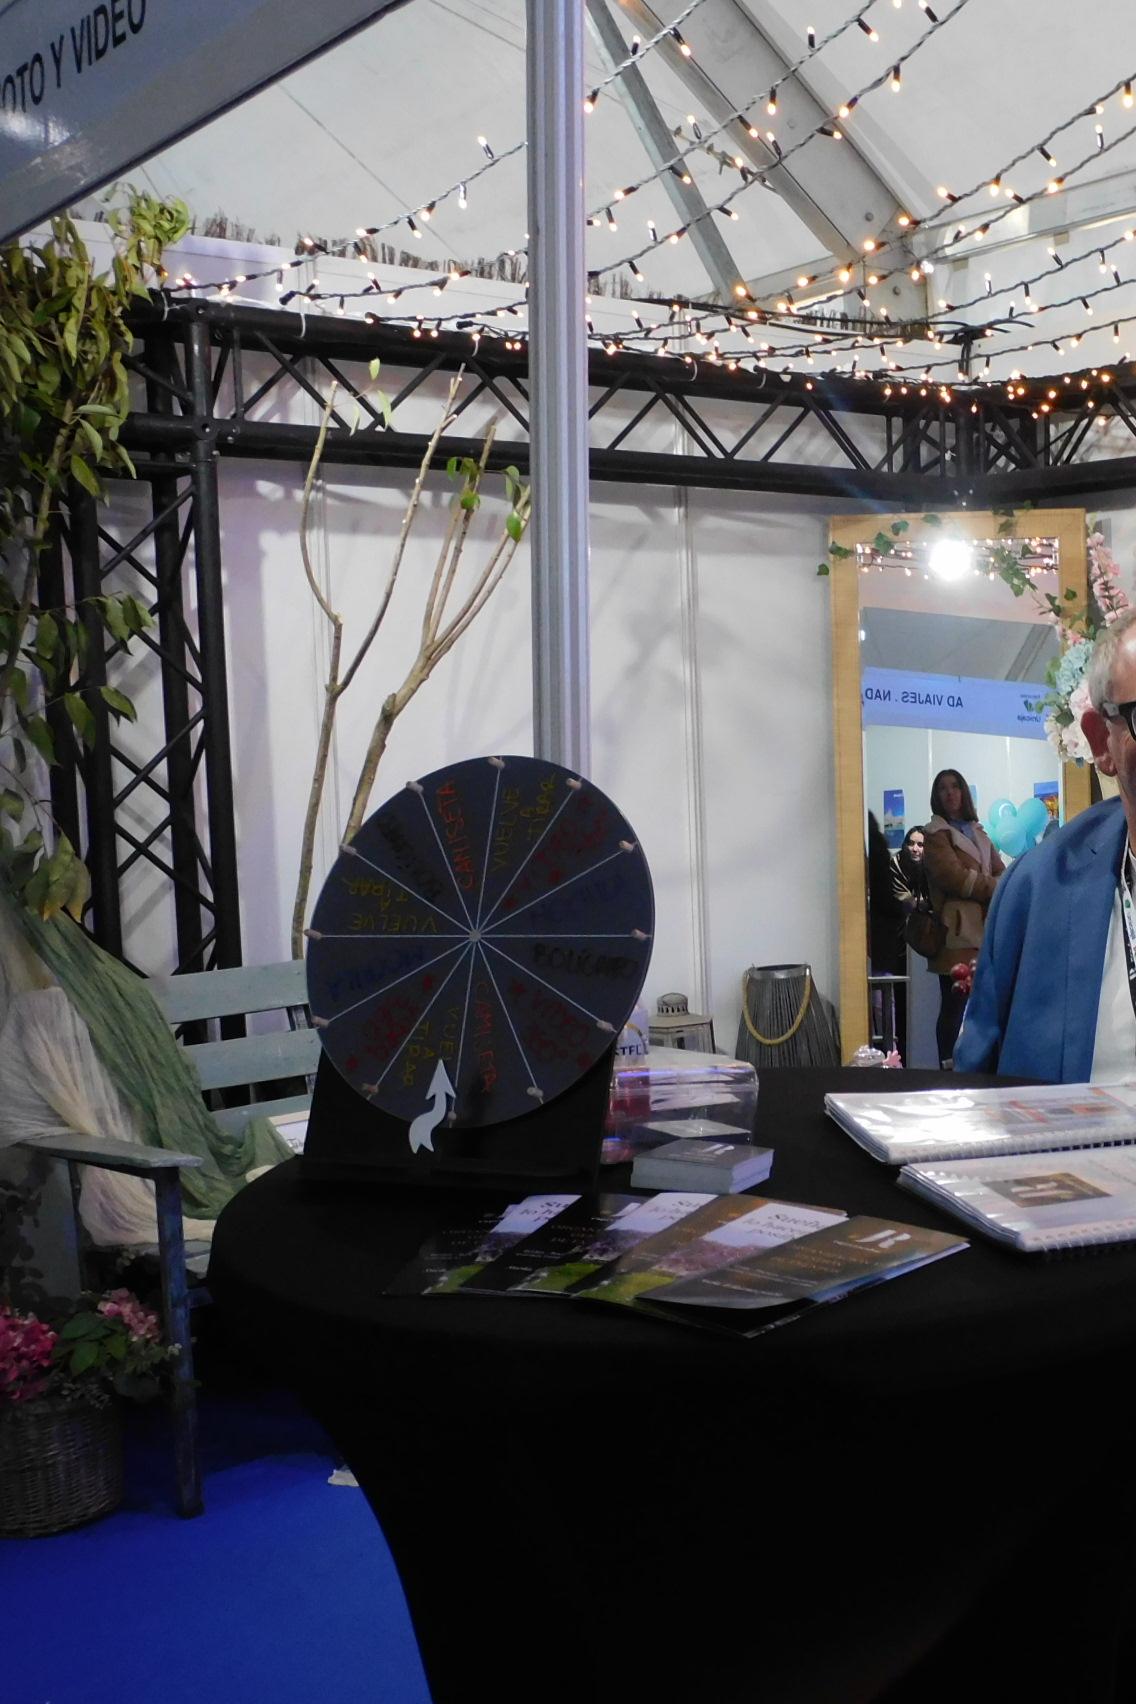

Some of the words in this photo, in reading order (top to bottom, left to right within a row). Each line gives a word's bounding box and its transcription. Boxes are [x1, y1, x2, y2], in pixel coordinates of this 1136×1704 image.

[0, 53, 44, 113] OTO
[50, 34, 64, 88] Y
[491, 787, 521, 873] VUELVE
[351, 912, 438, 932] VUELVE
